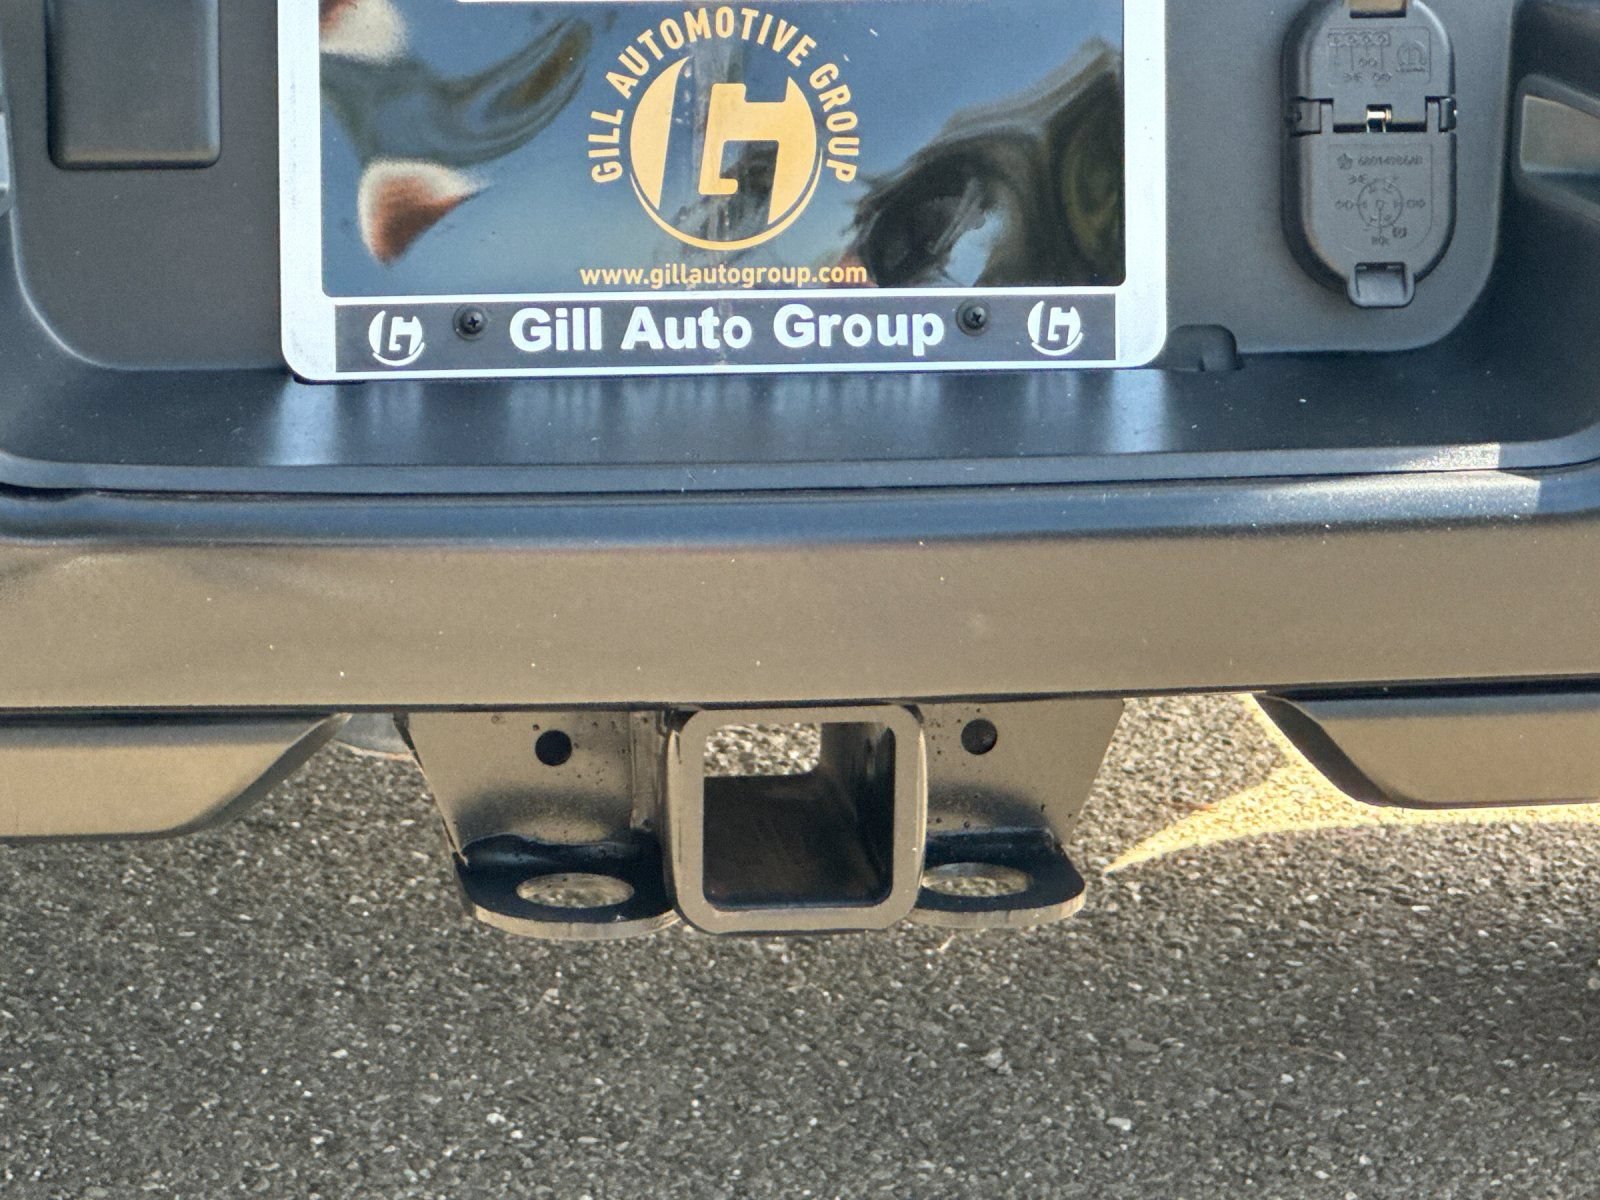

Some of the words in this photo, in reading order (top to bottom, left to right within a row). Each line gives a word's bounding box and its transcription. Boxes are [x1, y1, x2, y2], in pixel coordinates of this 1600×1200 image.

[605, 6, 817, 99] AUTOMOTIVE
[587, 108, 624, 183] GILL
[809, 63, 861, 183] GROUP
[579, 263, 868, 289] www.gillautogroup.com
[508, 306, 604, 354] Gill
[620, 305, 754, 352] Auto
[772, 303, 946, 358] Group
